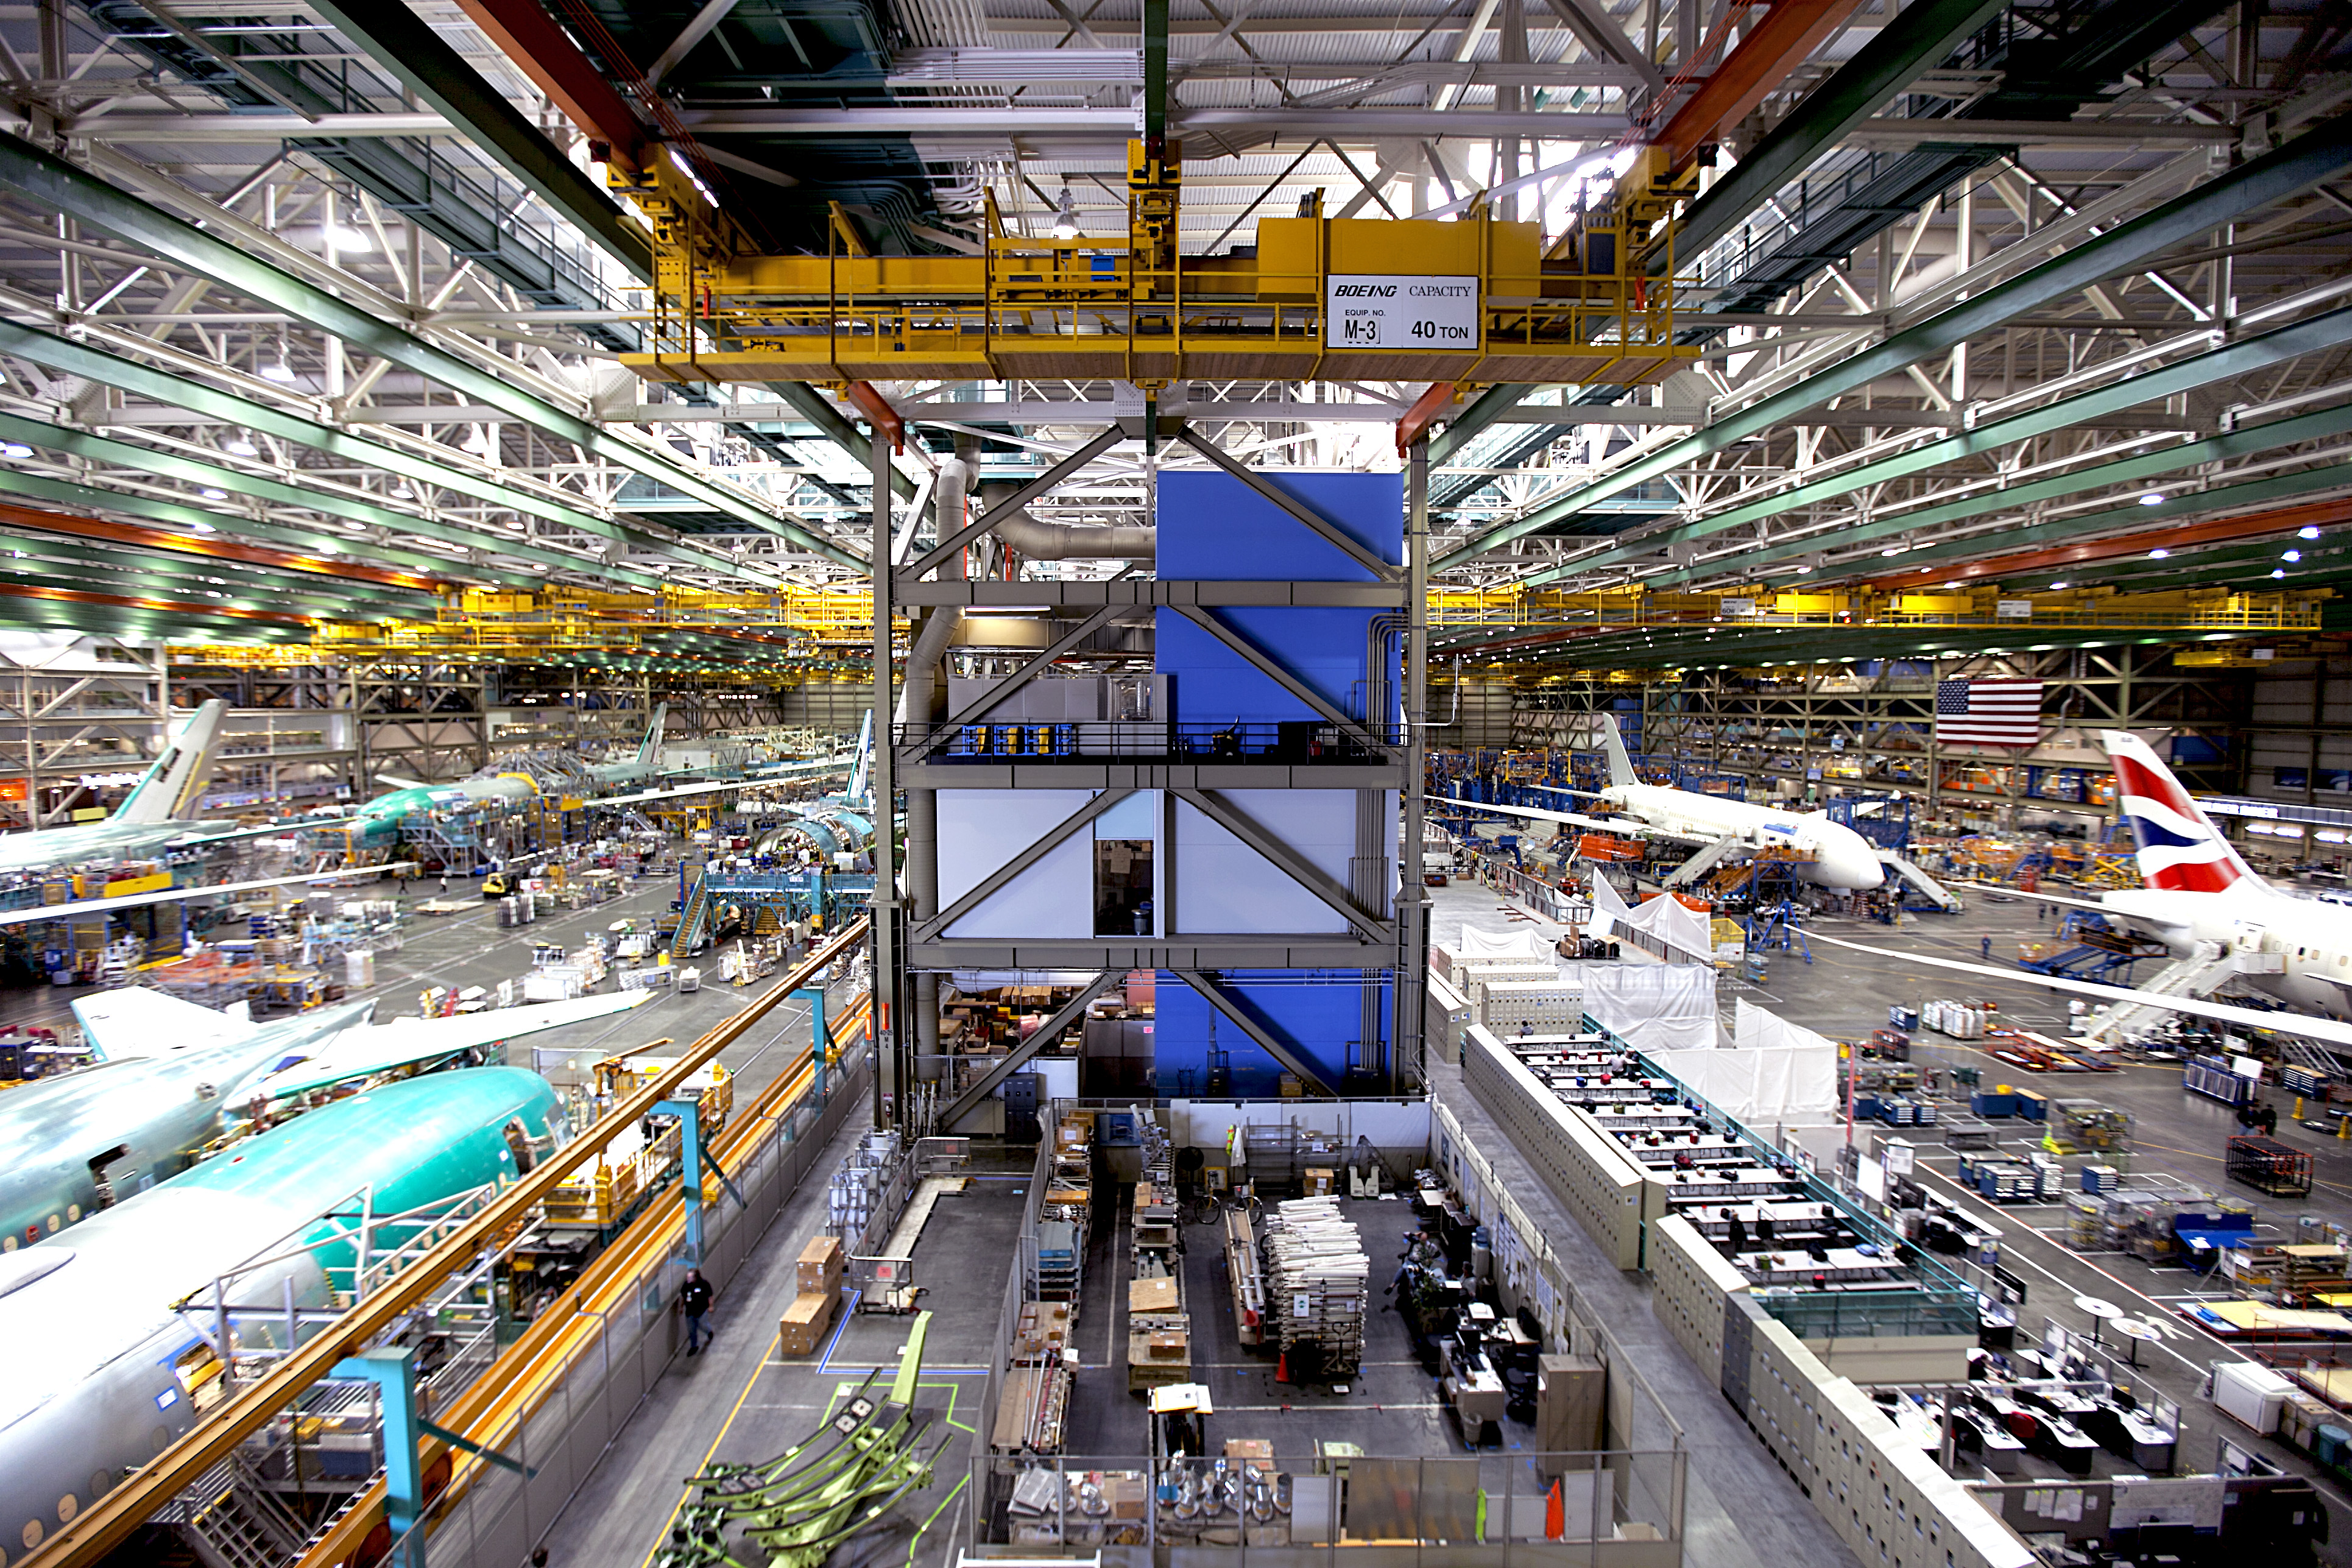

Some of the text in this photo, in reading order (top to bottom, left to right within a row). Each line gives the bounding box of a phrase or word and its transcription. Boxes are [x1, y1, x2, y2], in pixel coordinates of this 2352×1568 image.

[1334, 285, 1397, 297] BOEING
[1409, 286, 1471, 297] CAPACITY
[1344, 319, 1376, 339] M-3
[1411, 321, 1468, 339] 40 TON
